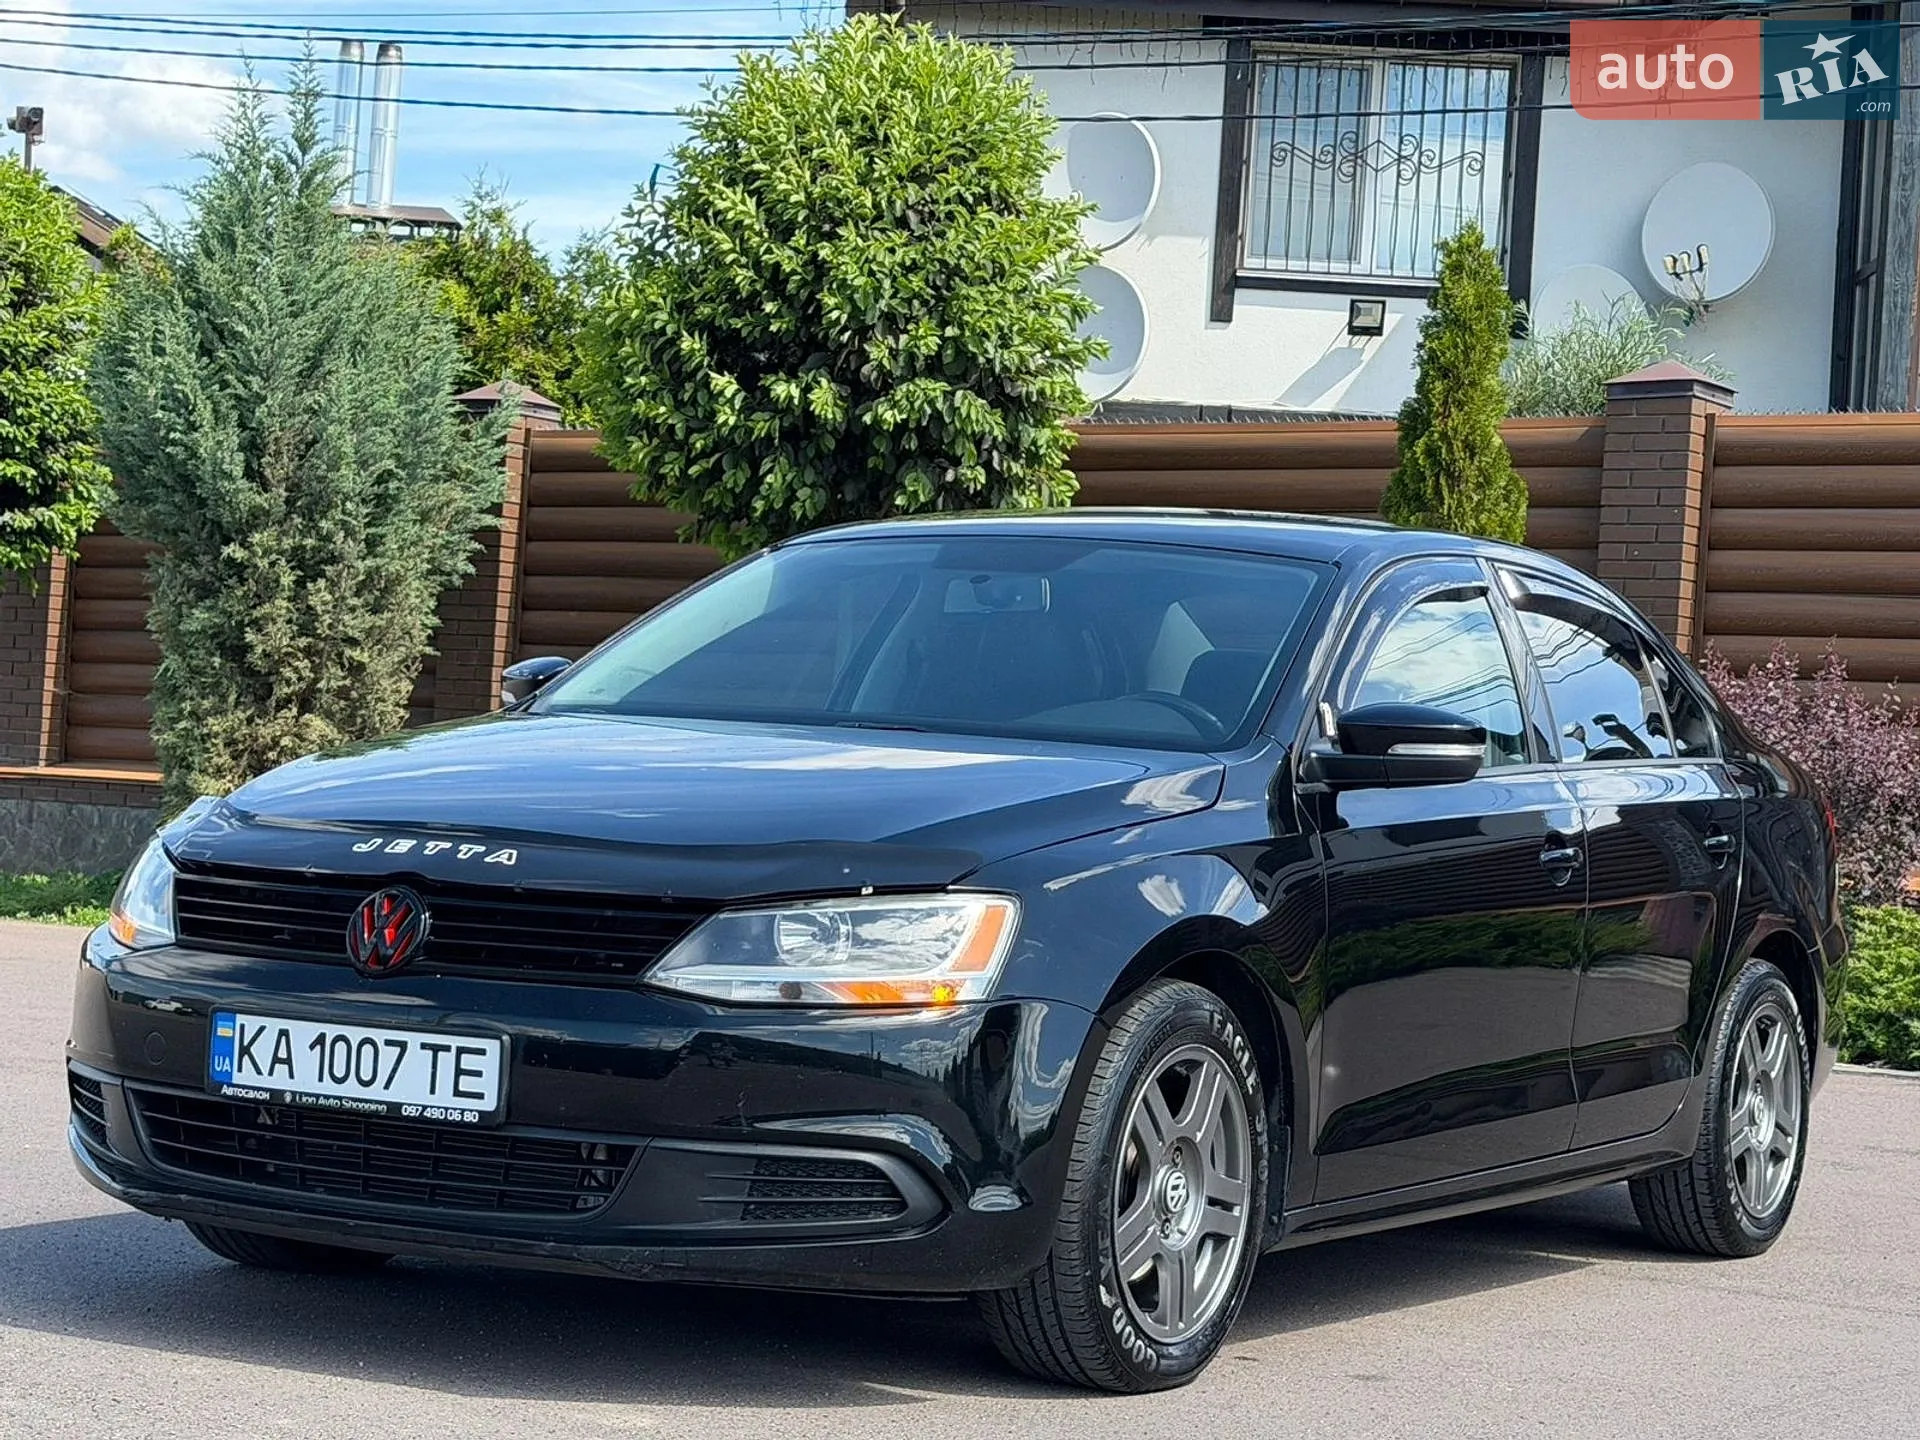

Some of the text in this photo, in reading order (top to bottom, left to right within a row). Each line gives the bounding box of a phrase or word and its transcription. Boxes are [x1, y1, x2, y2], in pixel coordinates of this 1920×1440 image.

[352, 838, 518, 865] JETTA
[214, 1055, 232, 1073] UA
[236, 1023, 488, 1101] KA 1007 TE
[1211, 1011, 1257, 1095] EAGLE
[296, 1093, 317, 1104] Lion
[341, 1098, 388, 1116] Shopping
[401, 1104, 479, 1122] 097 490 06 80
